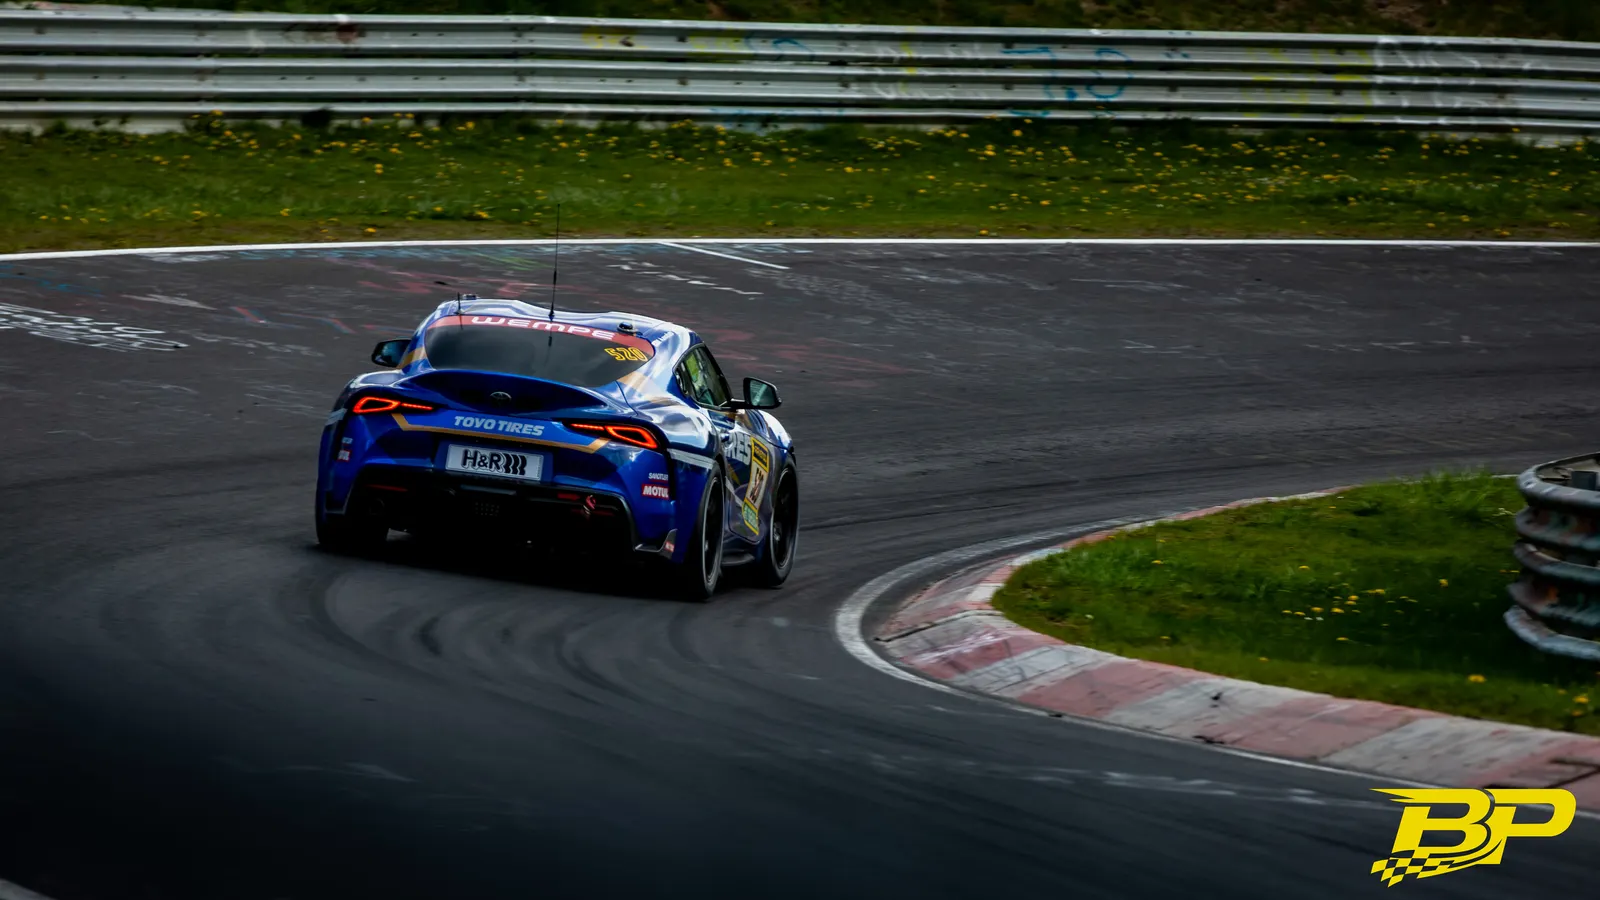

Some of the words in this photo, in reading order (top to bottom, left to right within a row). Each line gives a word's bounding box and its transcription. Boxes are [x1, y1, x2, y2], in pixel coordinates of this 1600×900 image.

[604, 347, 648, 362] 520
[454, 416, 496, 431] TOYO
[498, 420, 545, 437] TIRES
[462, 449, 504, 473] H&R
[642, 485, 669, 498] MOTUL
